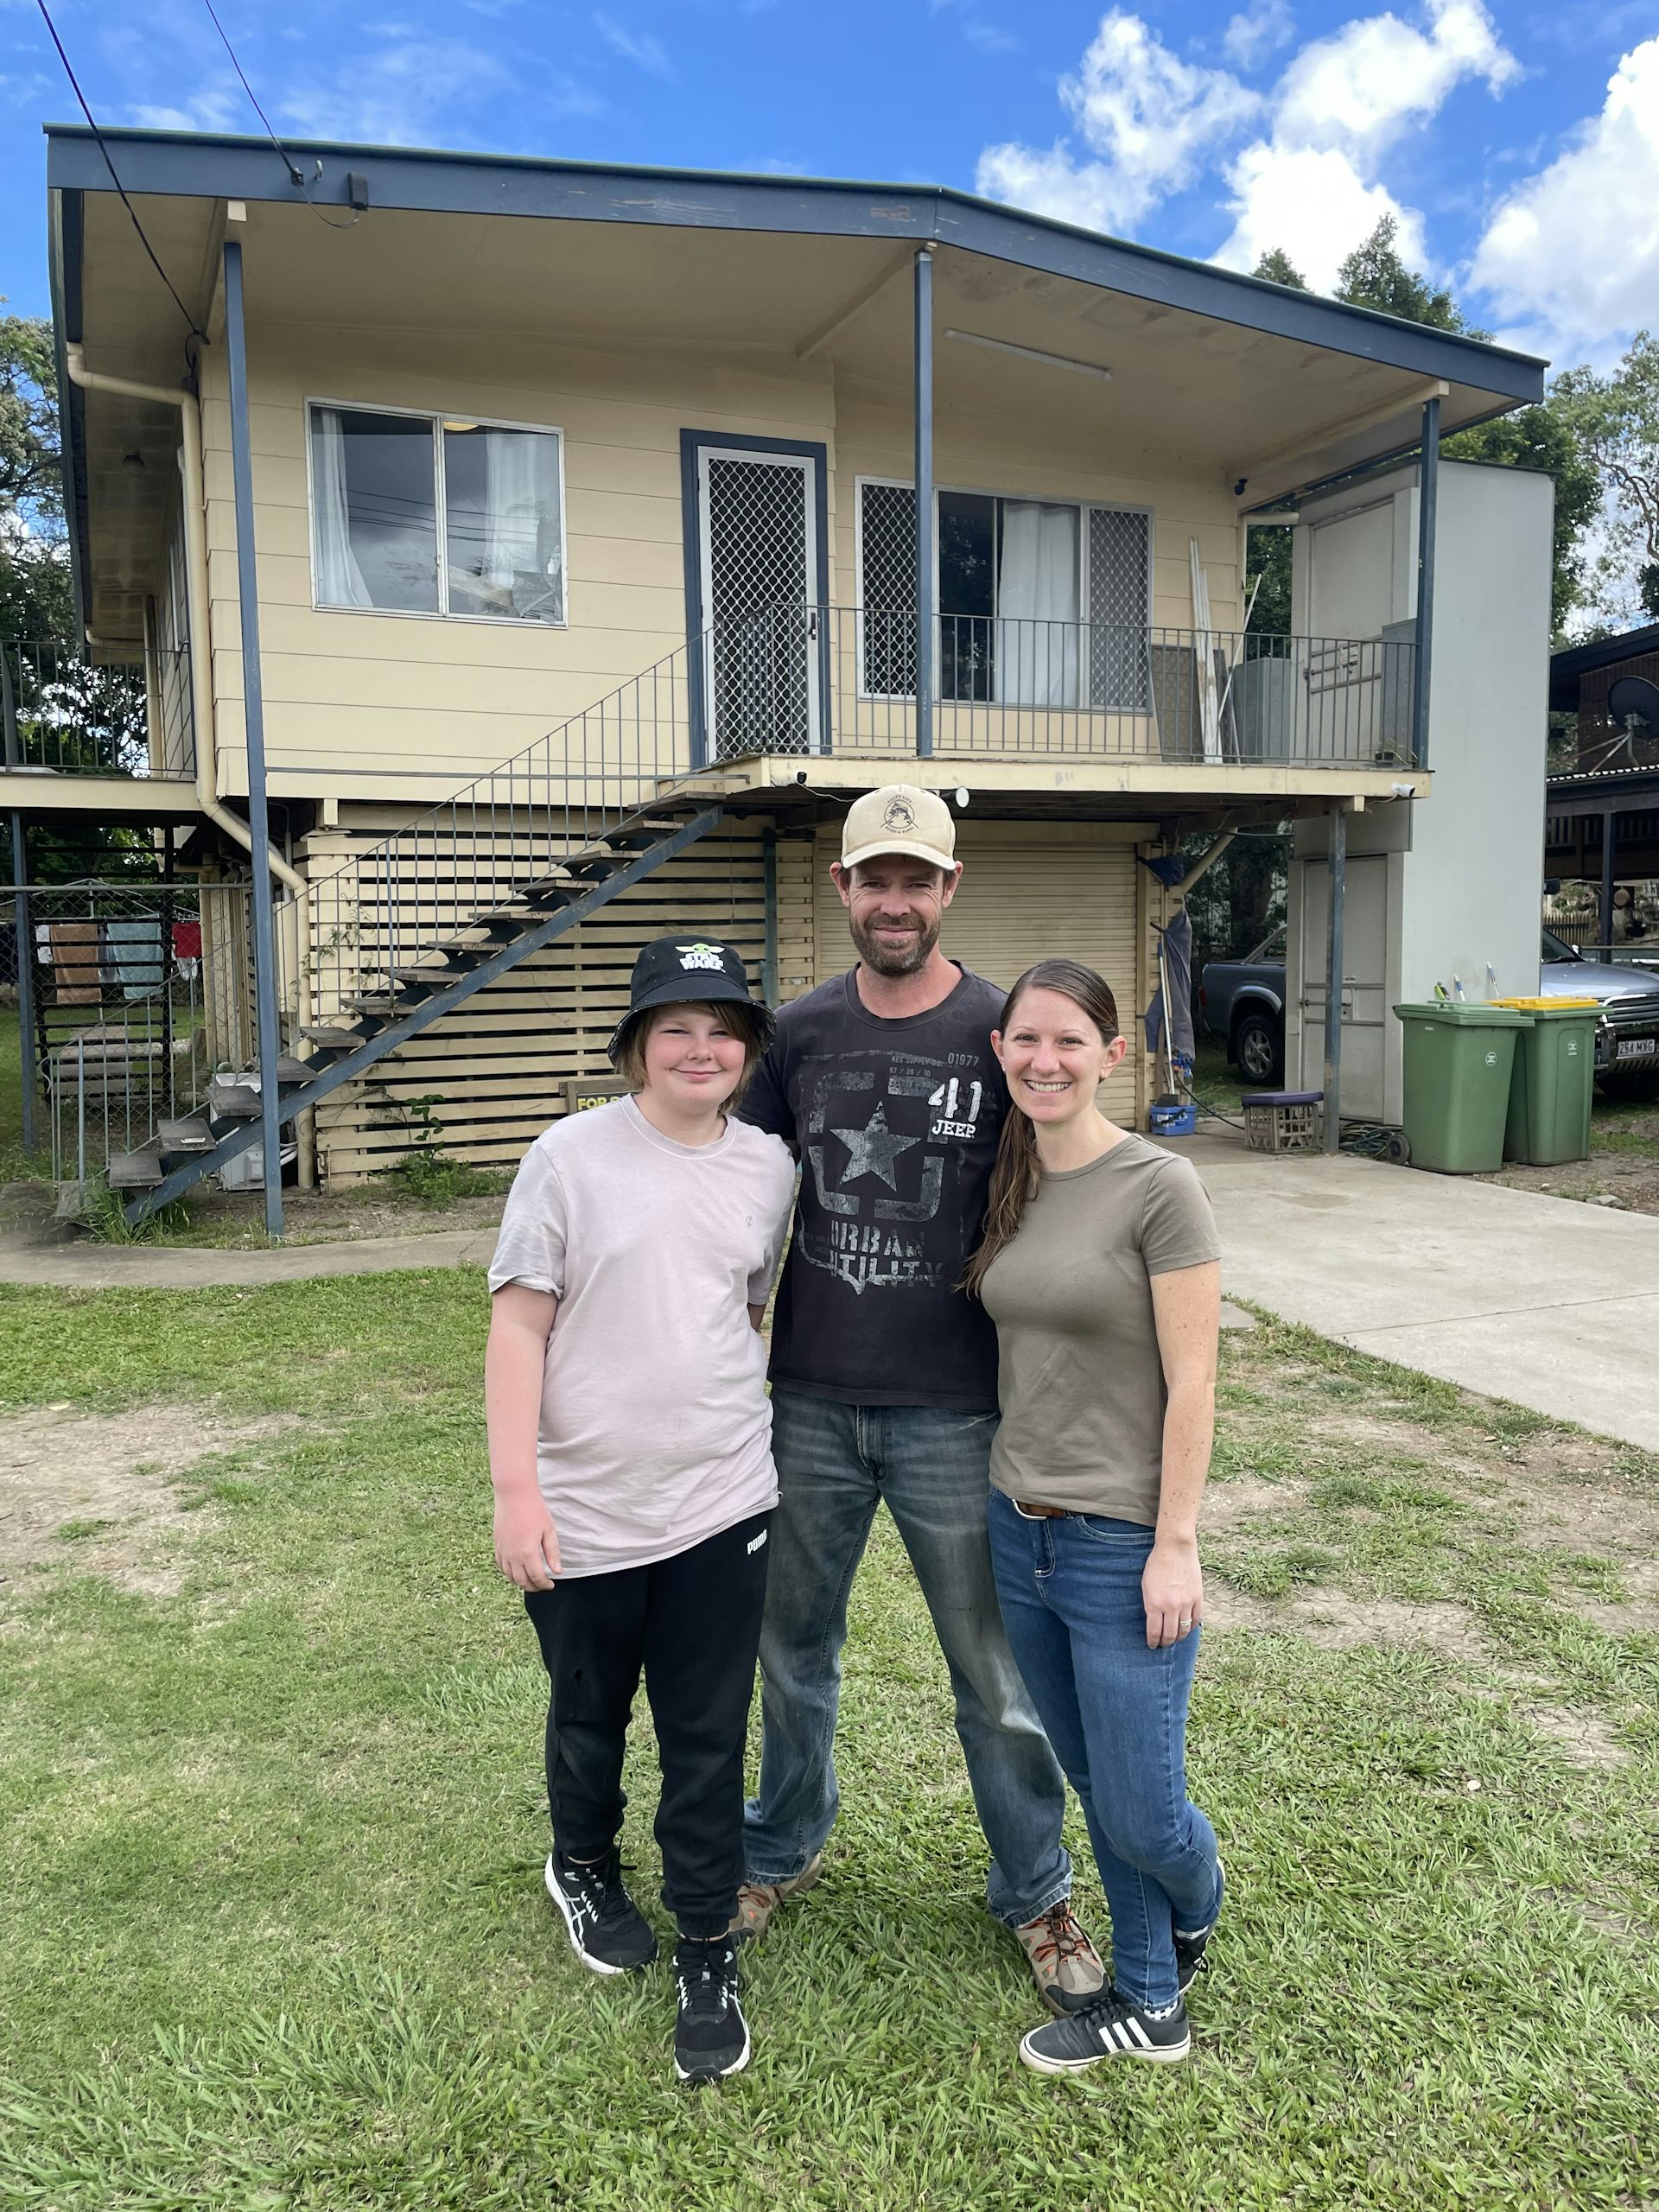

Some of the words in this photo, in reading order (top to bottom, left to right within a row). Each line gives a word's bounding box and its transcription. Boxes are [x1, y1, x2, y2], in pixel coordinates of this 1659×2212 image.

[679, 957, 726, 974] WARS
[947, 1052, 980, 1068] 01977
[577, 1096, 607, 1111] FOR
[928, 1077, 982, 1122] 41
[931, 1119, 976, 1139] JEEP
